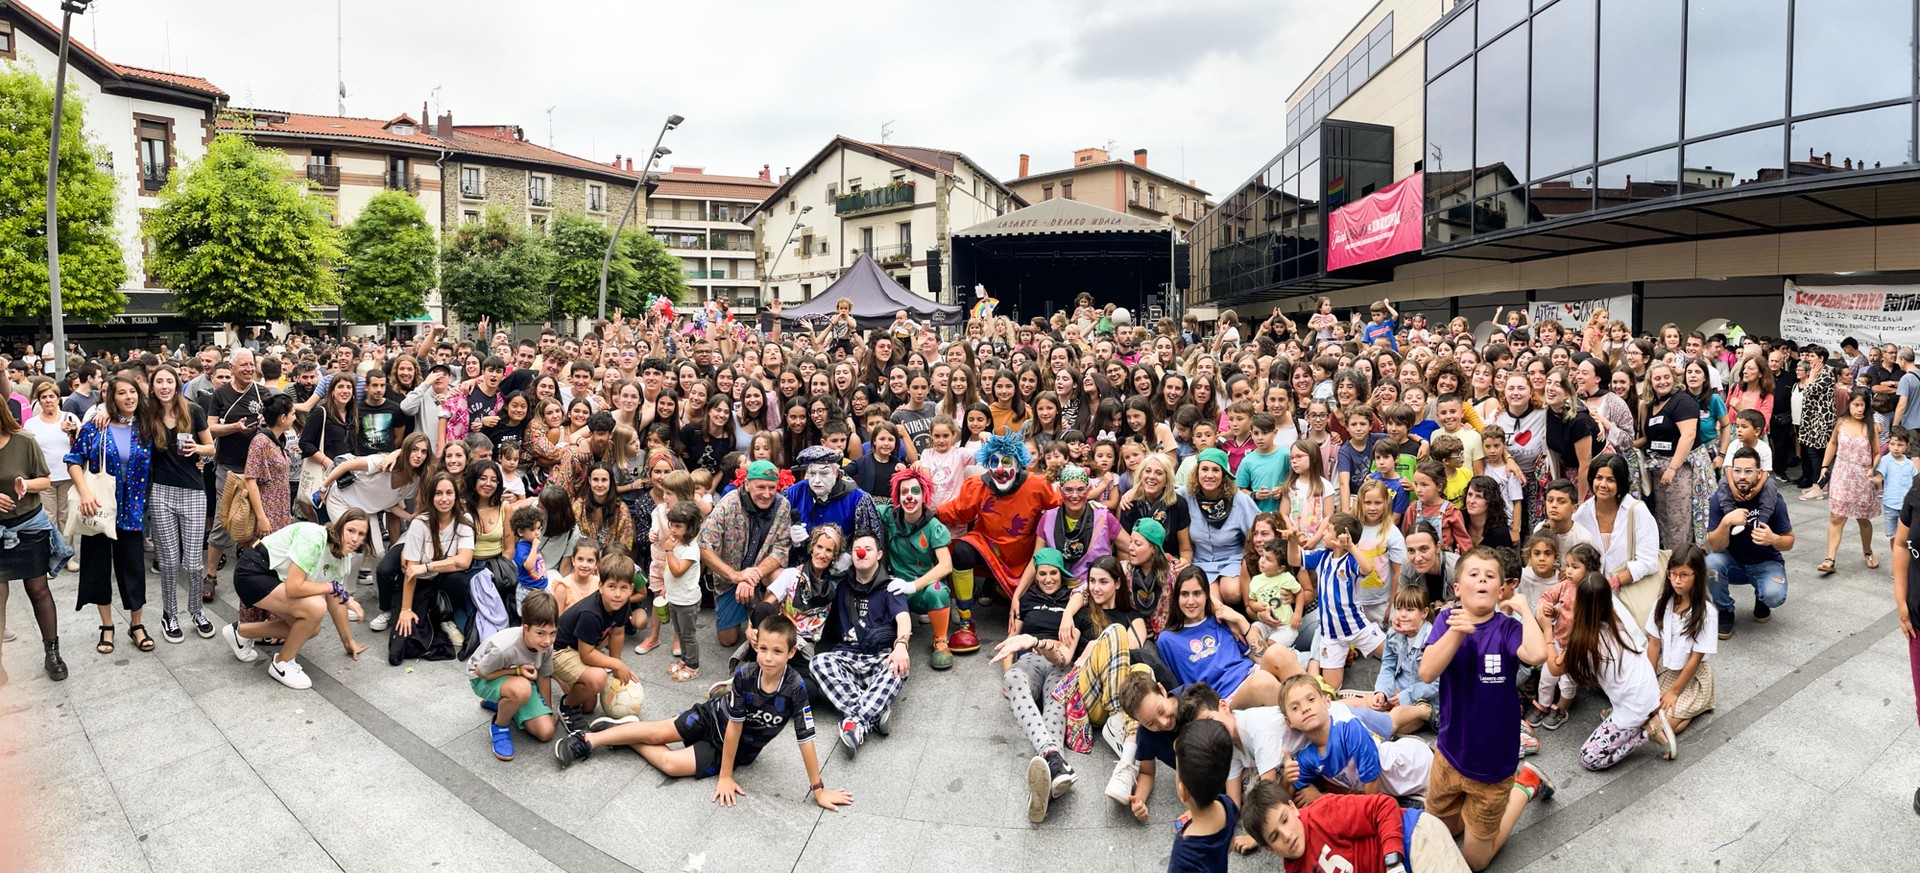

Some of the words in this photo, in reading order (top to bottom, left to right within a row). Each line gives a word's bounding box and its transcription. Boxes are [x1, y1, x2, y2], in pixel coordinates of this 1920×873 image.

[997, 219, 1039, 229] LASARTE
[1050, 218, 1086, 227] ORIAKO
[1091, 217, 1122, 226] UDALA
[131, 316, 158, 325] KEBAB
